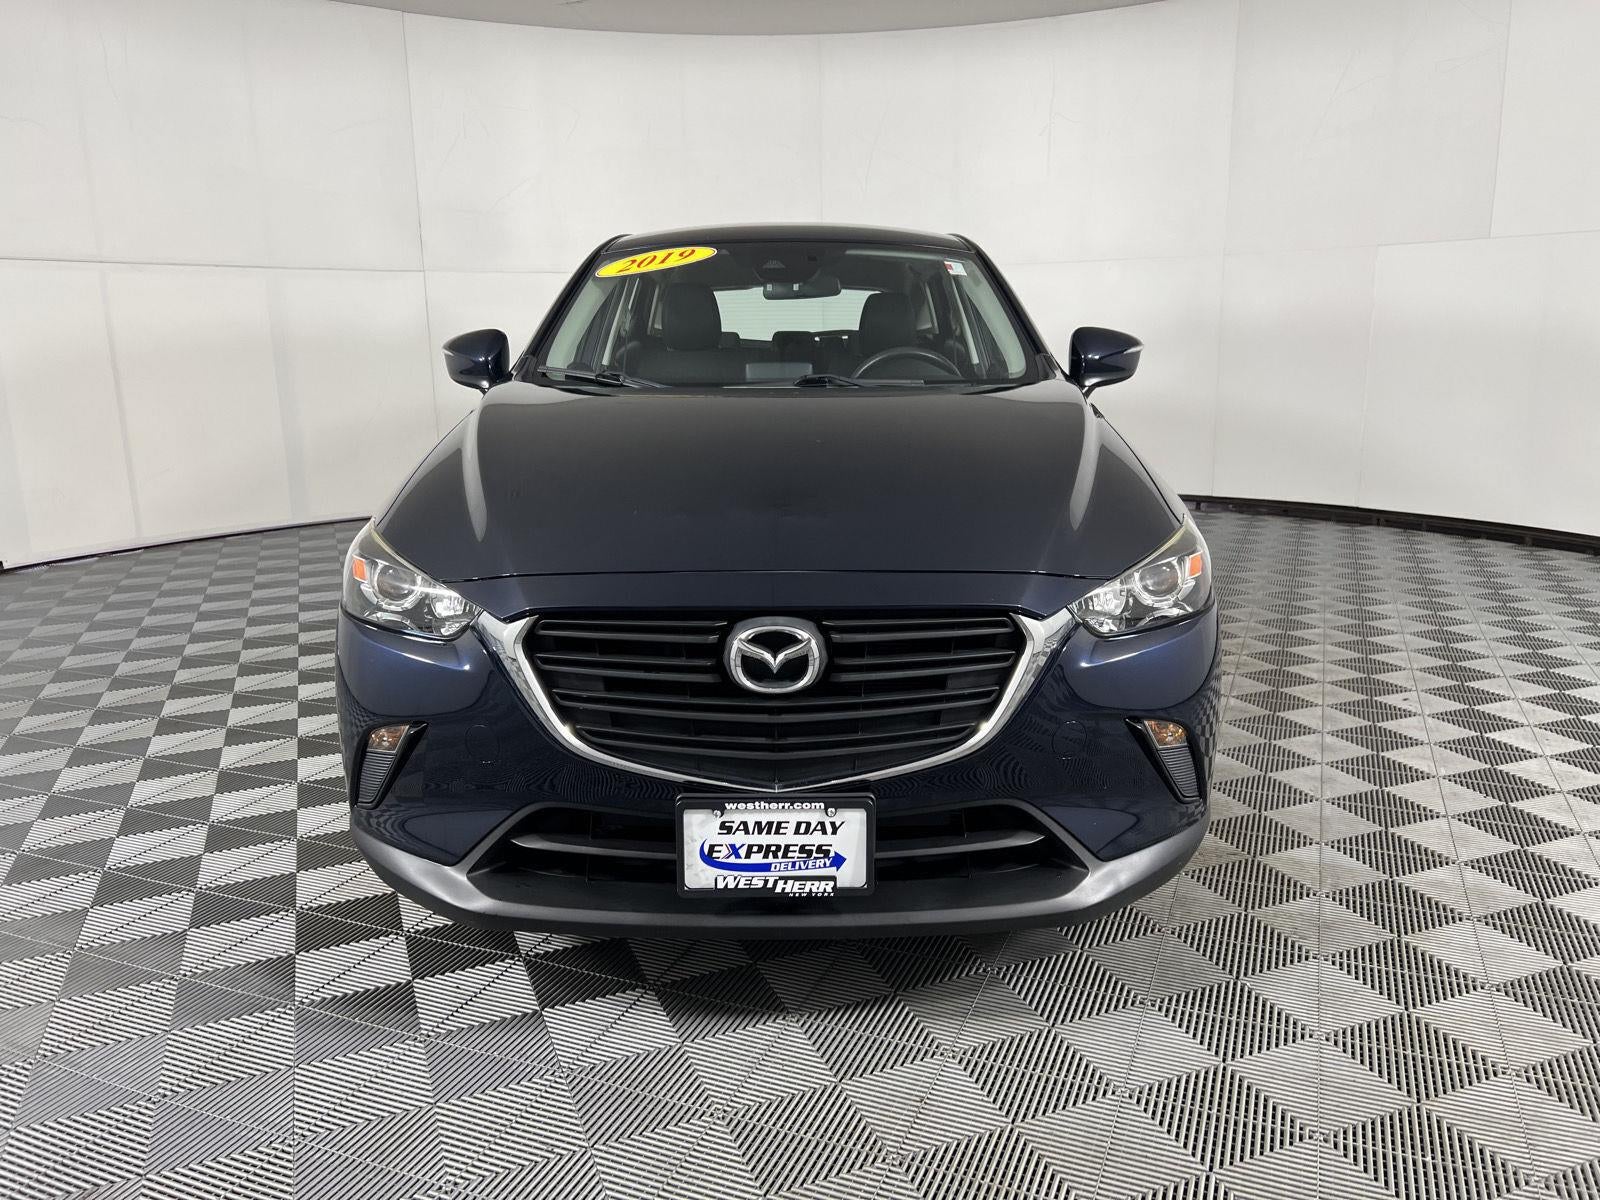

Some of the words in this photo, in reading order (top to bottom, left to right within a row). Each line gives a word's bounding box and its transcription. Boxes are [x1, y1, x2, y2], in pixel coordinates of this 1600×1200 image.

[616, 249, 696, 273] 2019
[725, 801, 825, 810] westherr.com
[717, 820, 790, 836] SAME
[793, 820, 846, 836] DAY
[706, 843, 833, 860] EXPRESS
[770, 857, 834, 872] DELIVERY
